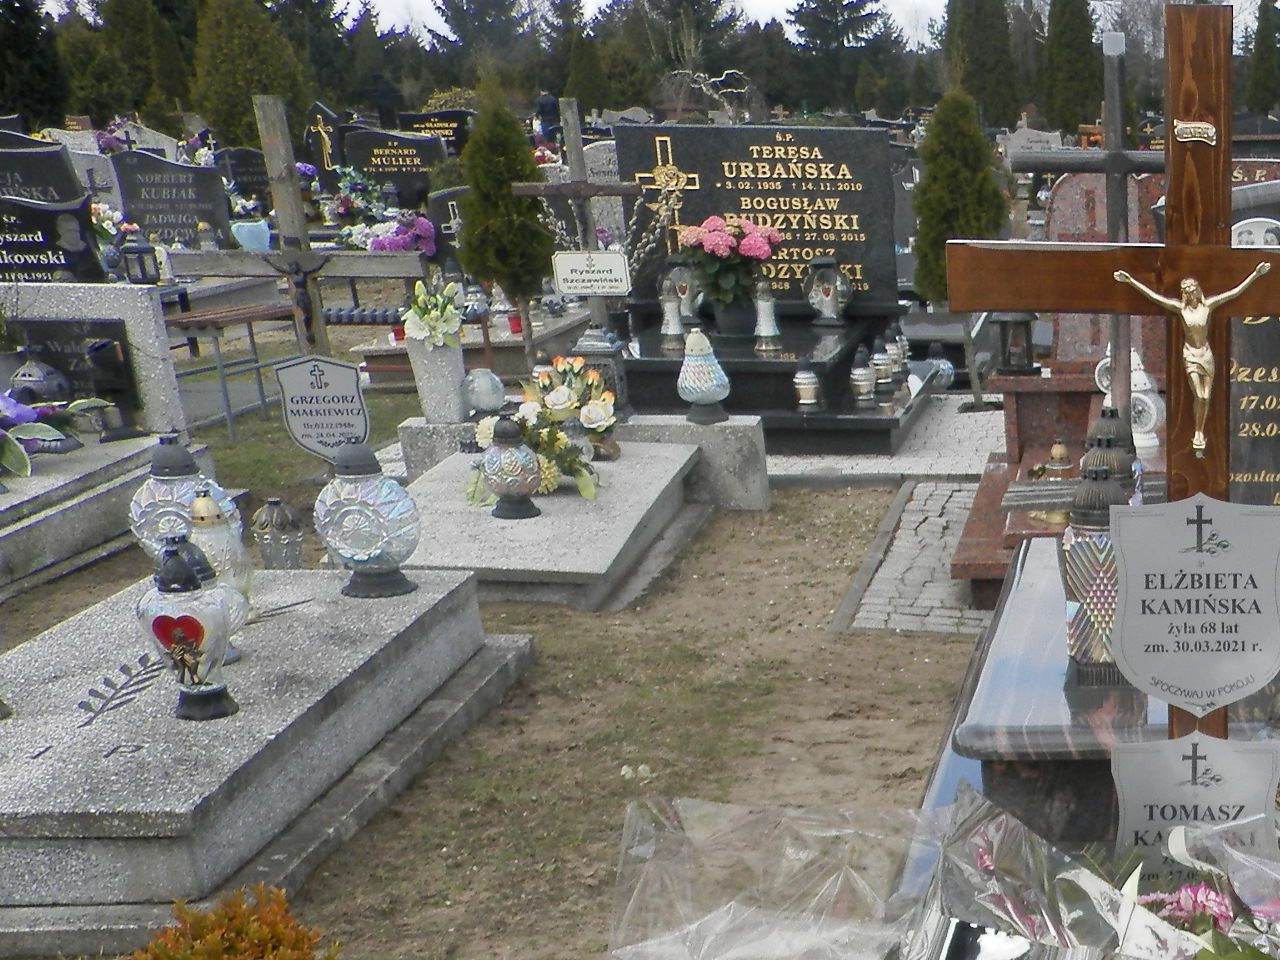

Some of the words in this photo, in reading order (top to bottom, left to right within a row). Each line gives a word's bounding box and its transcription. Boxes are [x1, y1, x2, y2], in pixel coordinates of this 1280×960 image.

[373, 148, 416, 156] BERNARD
[749, 146, 823, 159] TERESA
[722, 158, 853, 180] URBAŃSKA
[136, 173, 196, 185] NORBERT
[140, 188, 198, 200] KUBIAK
[741, 197, 840, 211] BOGUSŁAW
[0, 250, 66, 264] kowski
[570, 268, 613, 276] Ryszard
[290, 395, 357, 405] GRZEGORZ
[290, 408, 363, 417] MAŁKIEWICZ
[1143, 569, 1258, 590] ELŻBIETA
[1140, 593, 1262, 615] KAMIŃSKA
[1167, 622, 1195, 637] żyła
[1200, 622, 1216, 634] 68
[1221, 621, 1239, 634] lat
[1143, 643, 1169, 653] zm.
[1173, 640, 1246, 653] 30.03.2021
[1251, 642, 1263, 652] r.
[1149, 676, 1203, 699] SPOCZYWAJ
[1206, 688, 1216, 698] W
[1217, 674, 1256, 696] POKOJU
[1143, 804, 1246, 821] TOMASZ
